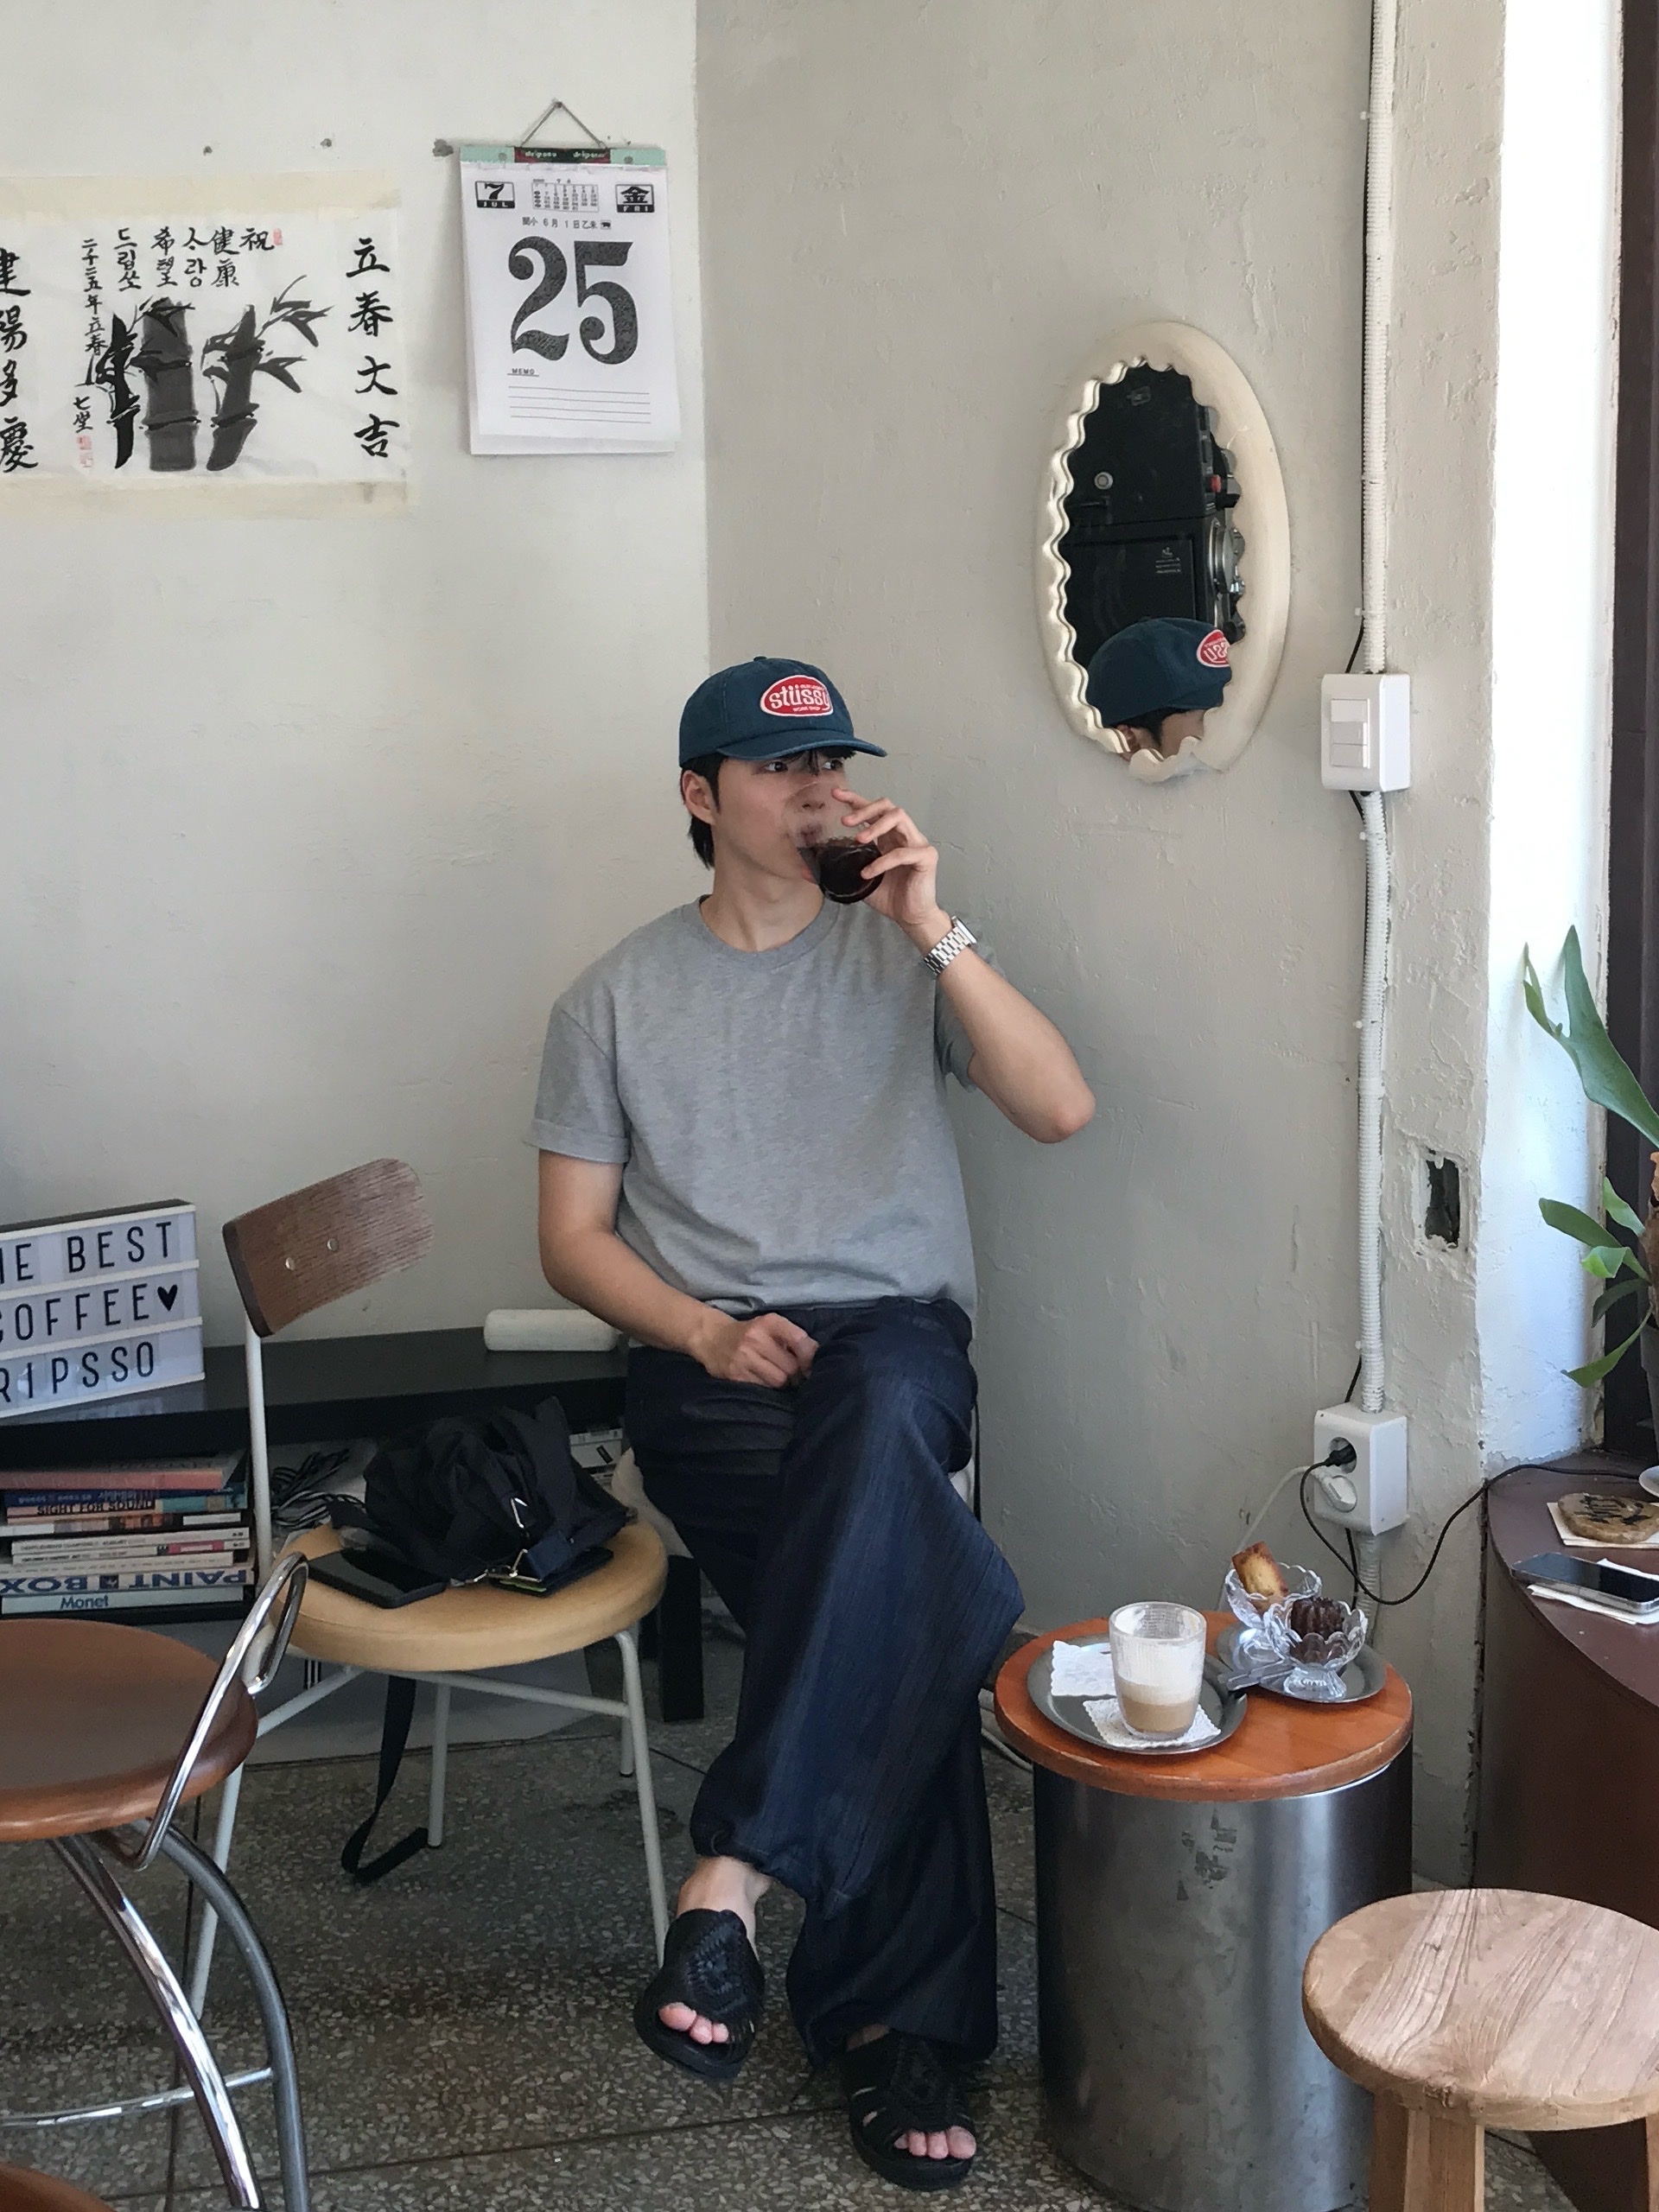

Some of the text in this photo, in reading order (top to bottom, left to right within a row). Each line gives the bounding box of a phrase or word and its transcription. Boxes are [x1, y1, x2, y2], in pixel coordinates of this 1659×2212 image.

[484, 182, 505, 200] 7
[620, 185, 650, 204] 金
[150, 226, 178, 288] 希望
[239, 227, 275, 251] 祝
[508, 235, 639, 365] 25
[346, 237, 400, 458] 立春大吉
[67, 1221, 172, 1274] BEST
[0, 1283, 149, 1341] OFFEE
[0, 1569, 247, 1595] PAINT BOX
[60, 1594, 109, 1610] Monet
